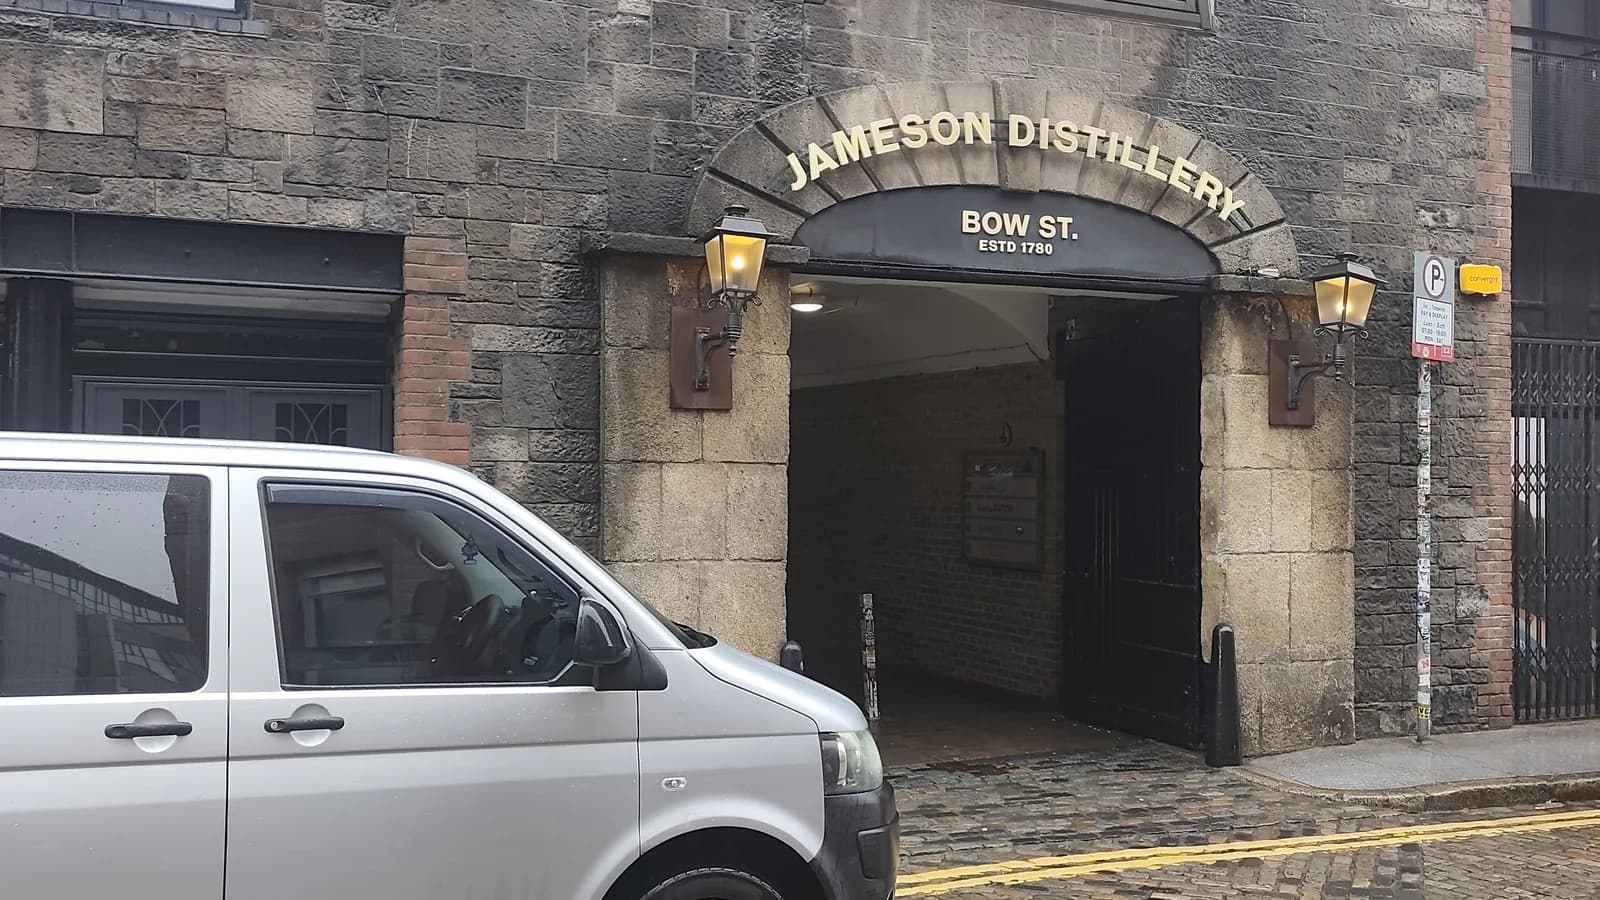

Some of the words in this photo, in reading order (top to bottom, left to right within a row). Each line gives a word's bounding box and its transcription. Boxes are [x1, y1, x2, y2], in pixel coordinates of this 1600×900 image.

[786, 111, 993, 192] JAMESON
[1008, 113, 1246, 222] DISTILLERY
[961, 210, 1031, 237] BOW
[1038, 215, 1079, 240] ST.
[978, 239, 1017, 255] ESTD
[1020, 241, 1054, 256] 1780
